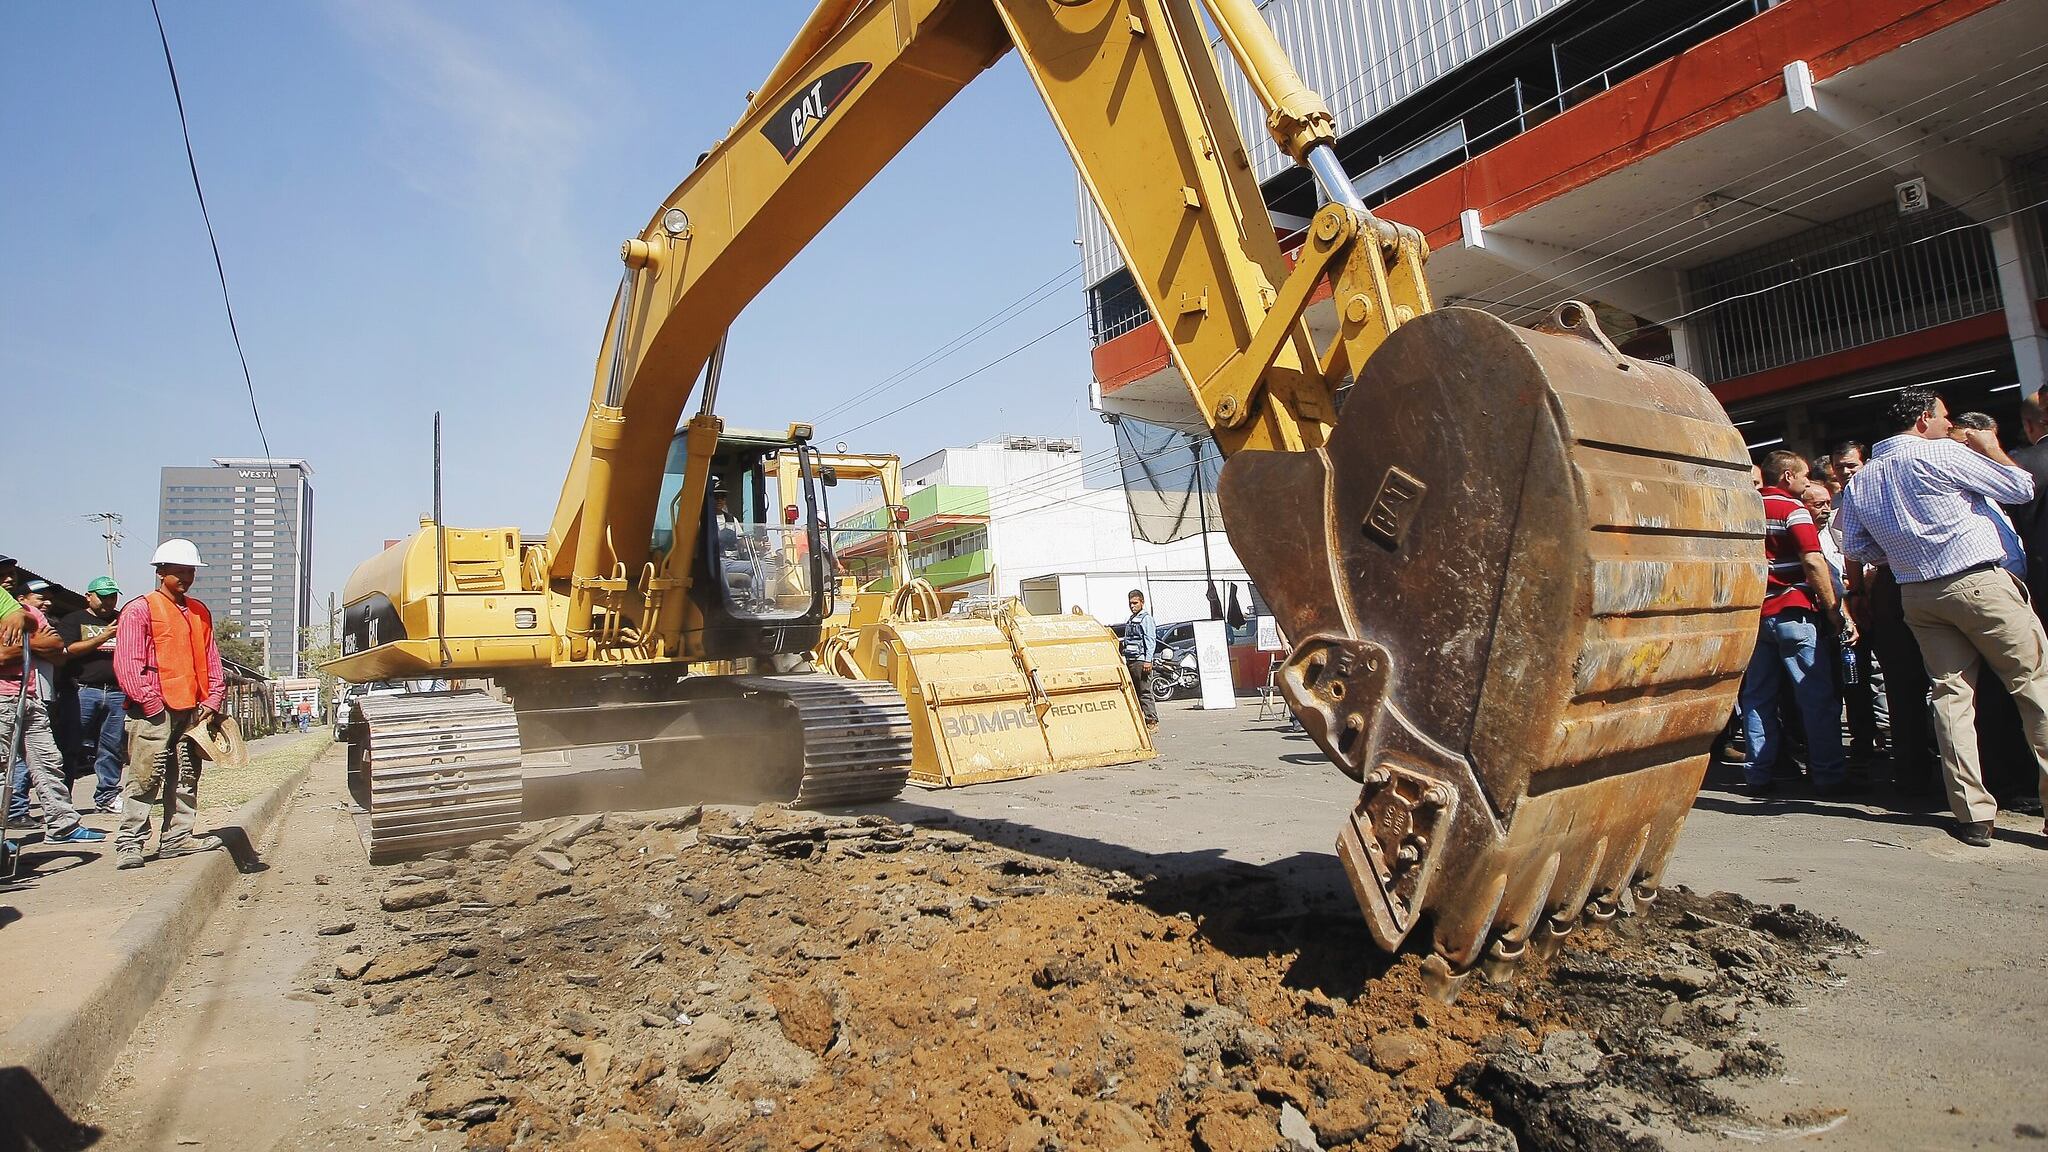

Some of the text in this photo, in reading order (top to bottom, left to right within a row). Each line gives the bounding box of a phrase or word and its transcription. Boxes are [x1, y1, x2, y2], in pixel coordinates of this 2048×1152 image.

[791, 79, 823, 147] CAT
[1904, 184, 1918, 203] E
[1370, 477, 1417, 537] CAT
[941, 700, 1117, 739] BOMAG RECYCLER
